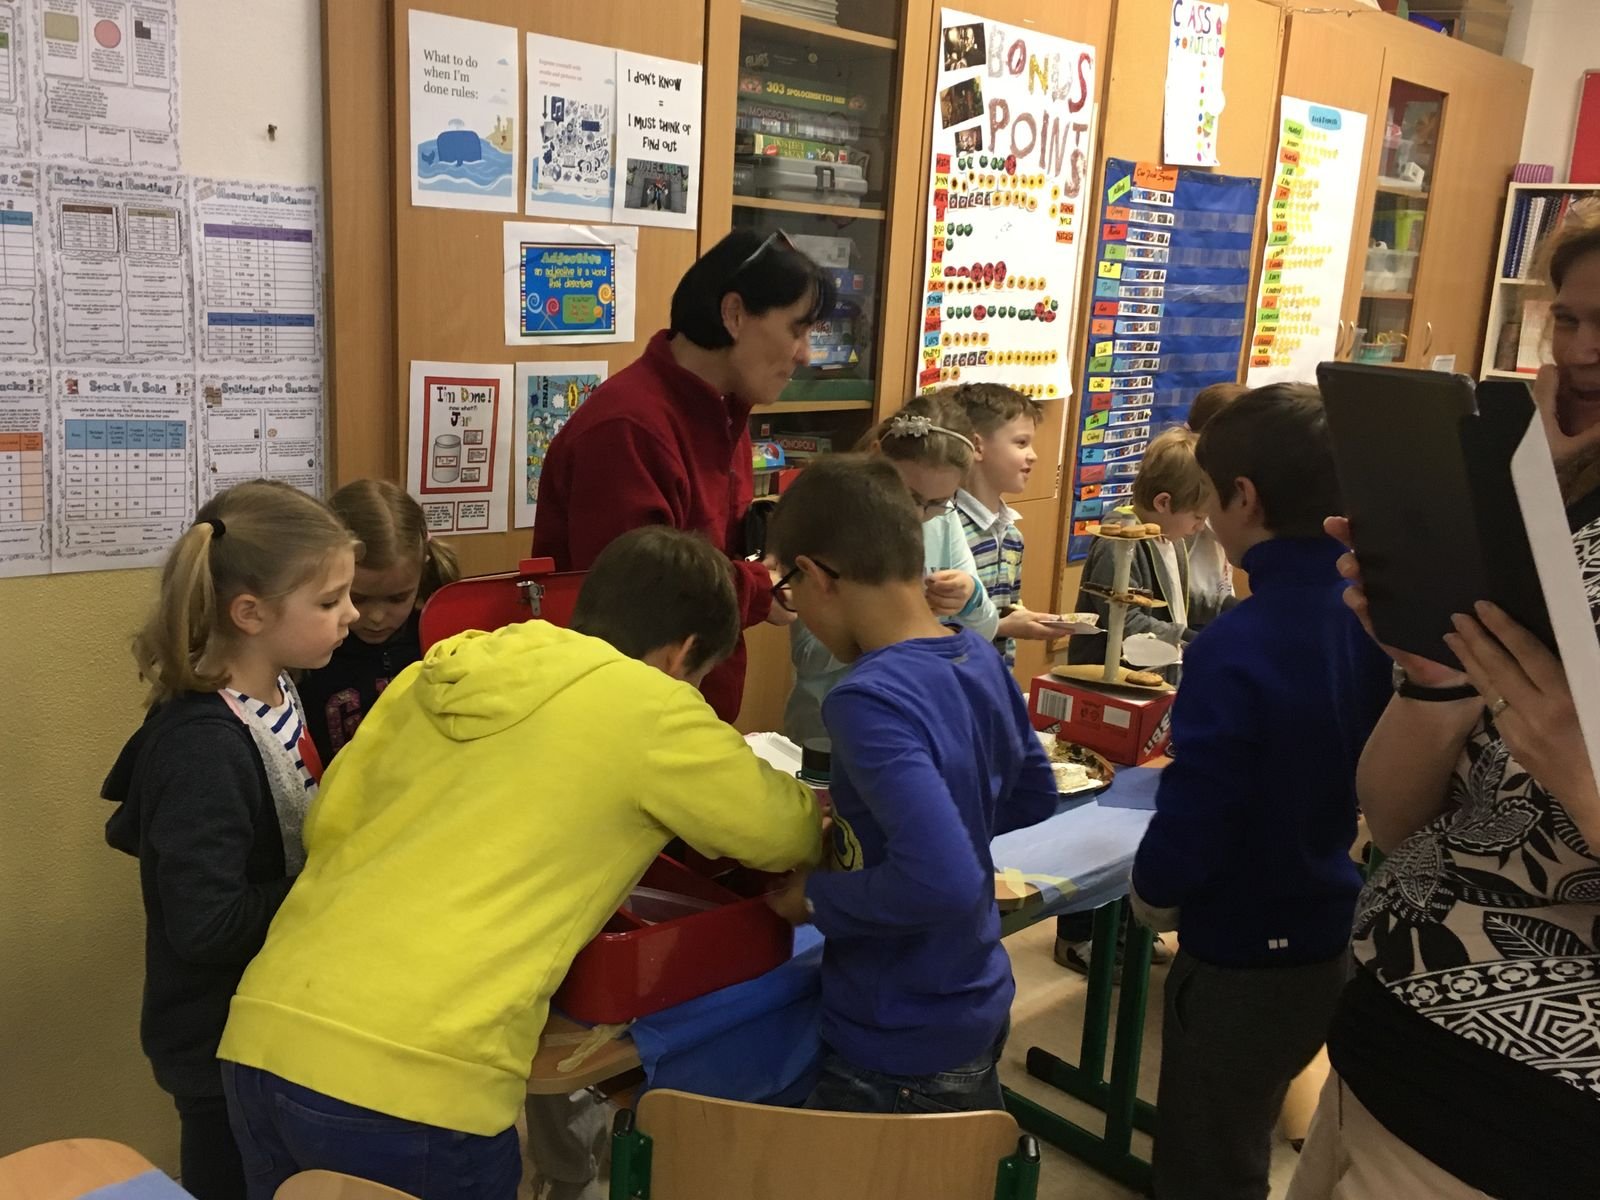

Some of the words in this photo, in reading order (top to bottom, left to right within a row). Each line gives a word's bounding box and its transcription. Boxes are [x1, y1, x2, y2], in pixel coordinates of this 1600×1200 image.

[423, 48, 450, 65] What
[453, 55, 463, 66] to
[465, 55, 478, 68] do
[423, 65, 450, 80] when
[454, 69, 470, 83] I'm
[627, 68, 631, 82] I
[987, 25, 1093, 113] BONUS
[423, 80, 449, 95] done
[451, 86, 478, 100] rules:
[766, 81, 785, 95] 303
[628, 113, 631, 127] I
[987, 98, 1088, 199] POINTS
[54, 172, 95, 188] Recipe
[97, 175, 123, 190] Card
[125, 177, 172, 194] Reading
[216, 187, 268, 204] Measuring
[592, 266, 607, 277] word
[89, 380, 120, 393] Stock
[142, 381, 167, 394] Sold
[268, 384, 283, 394] the
[436, 386, 455, 403] I'm
[461, 387, 492, 403] Done!
[450, 411, 472, 427] Jar
[781, 439, 816, 450] ONOPOLY
